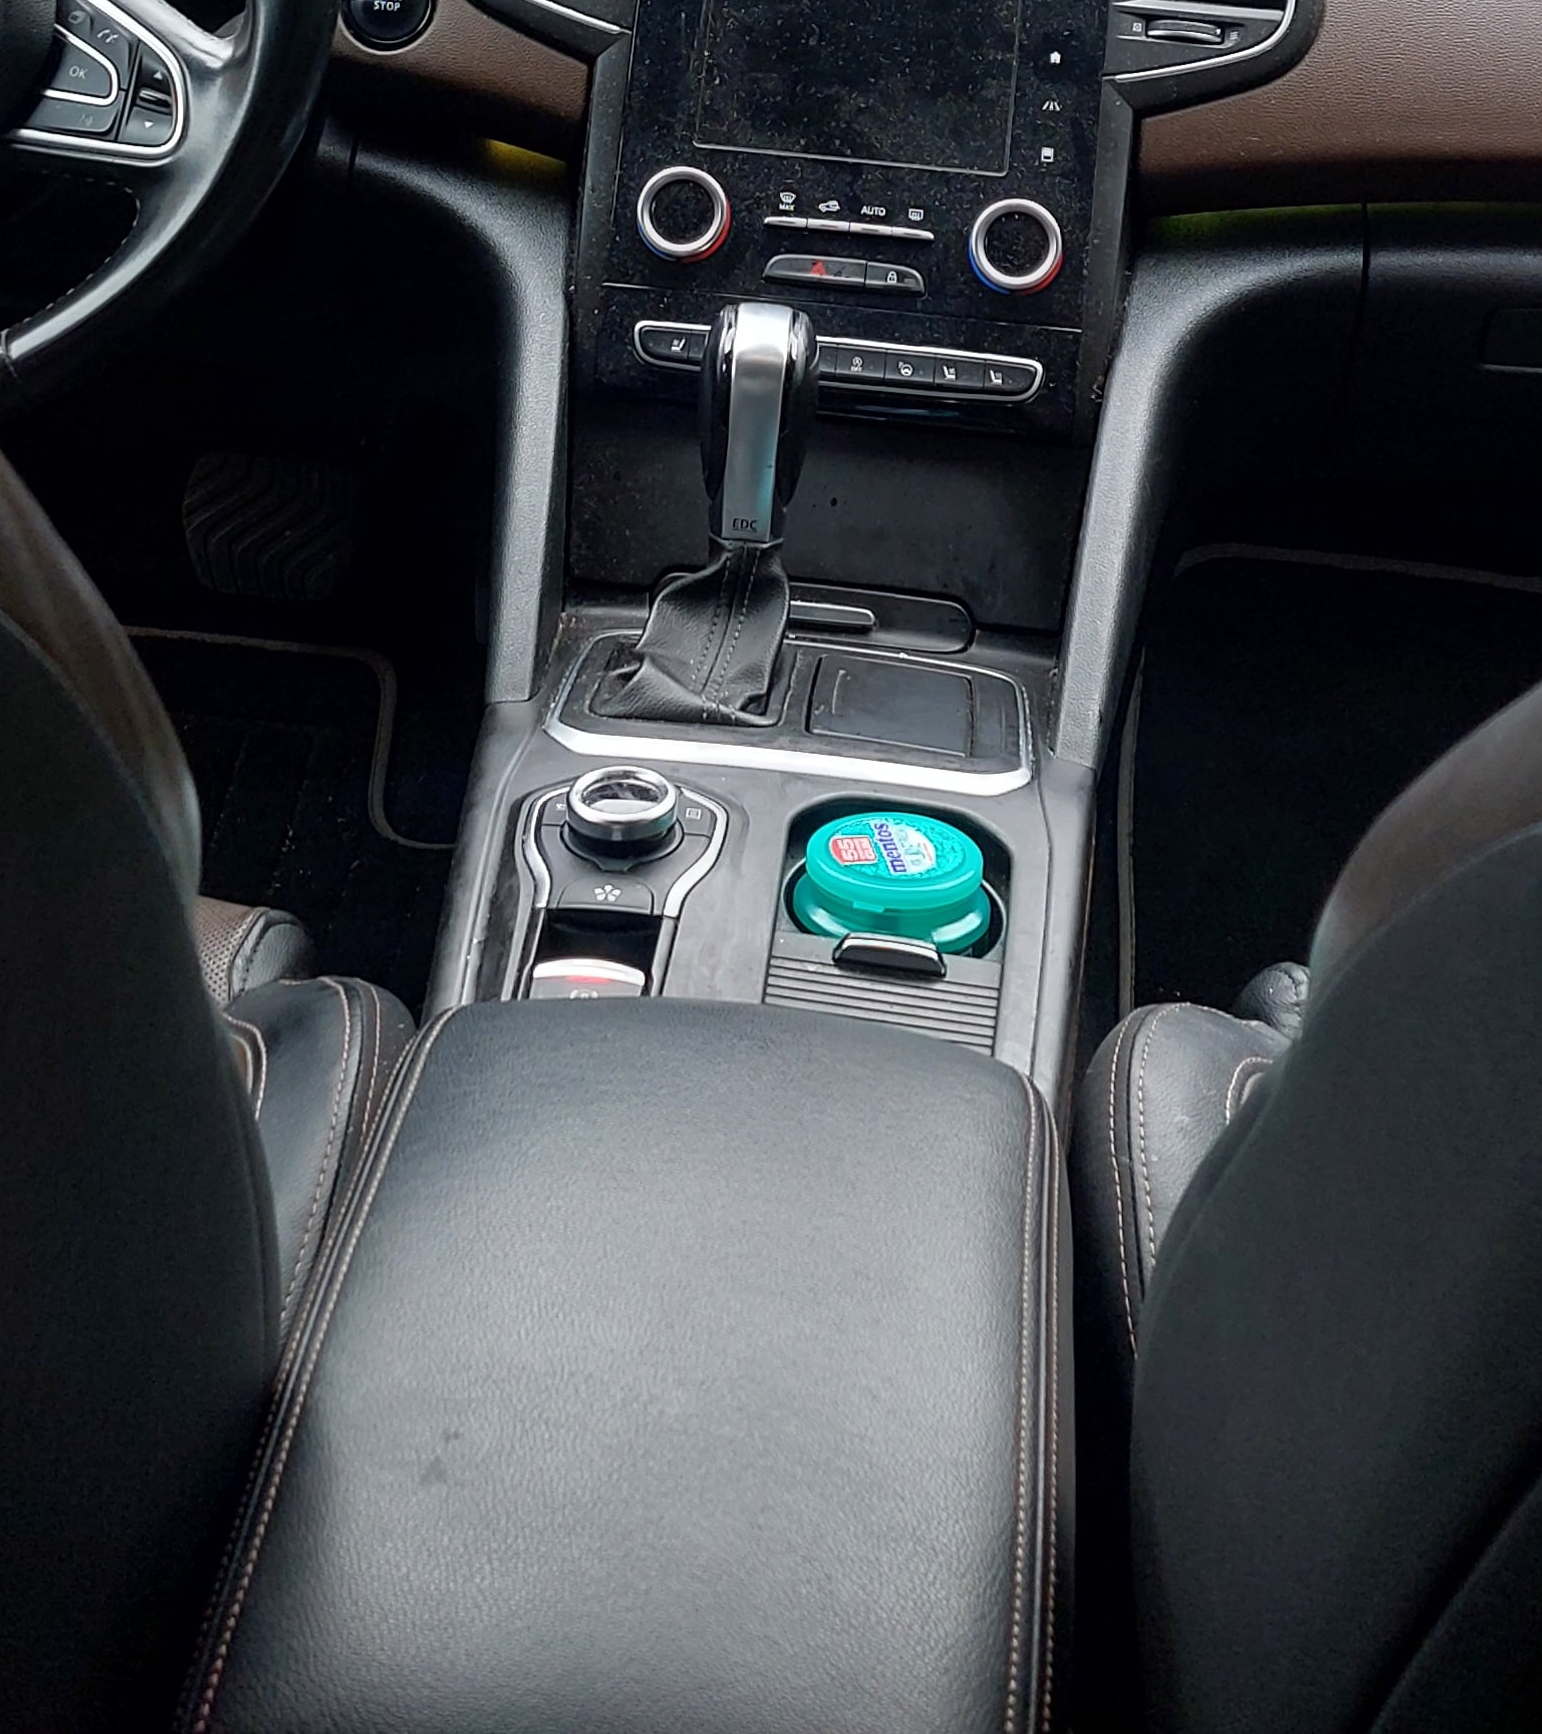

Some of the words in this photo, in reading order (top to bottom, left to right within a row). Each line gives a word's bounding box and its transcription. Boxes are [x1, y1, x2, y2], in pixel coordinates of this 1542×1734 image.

[373, 0, 401, 12] STOP
[69, 65, 88, 80] OK
[779, 203, 796, 212] MAX
[860, 205, 887, 217] AUTO
[874, 822, 908, 874] mentos
